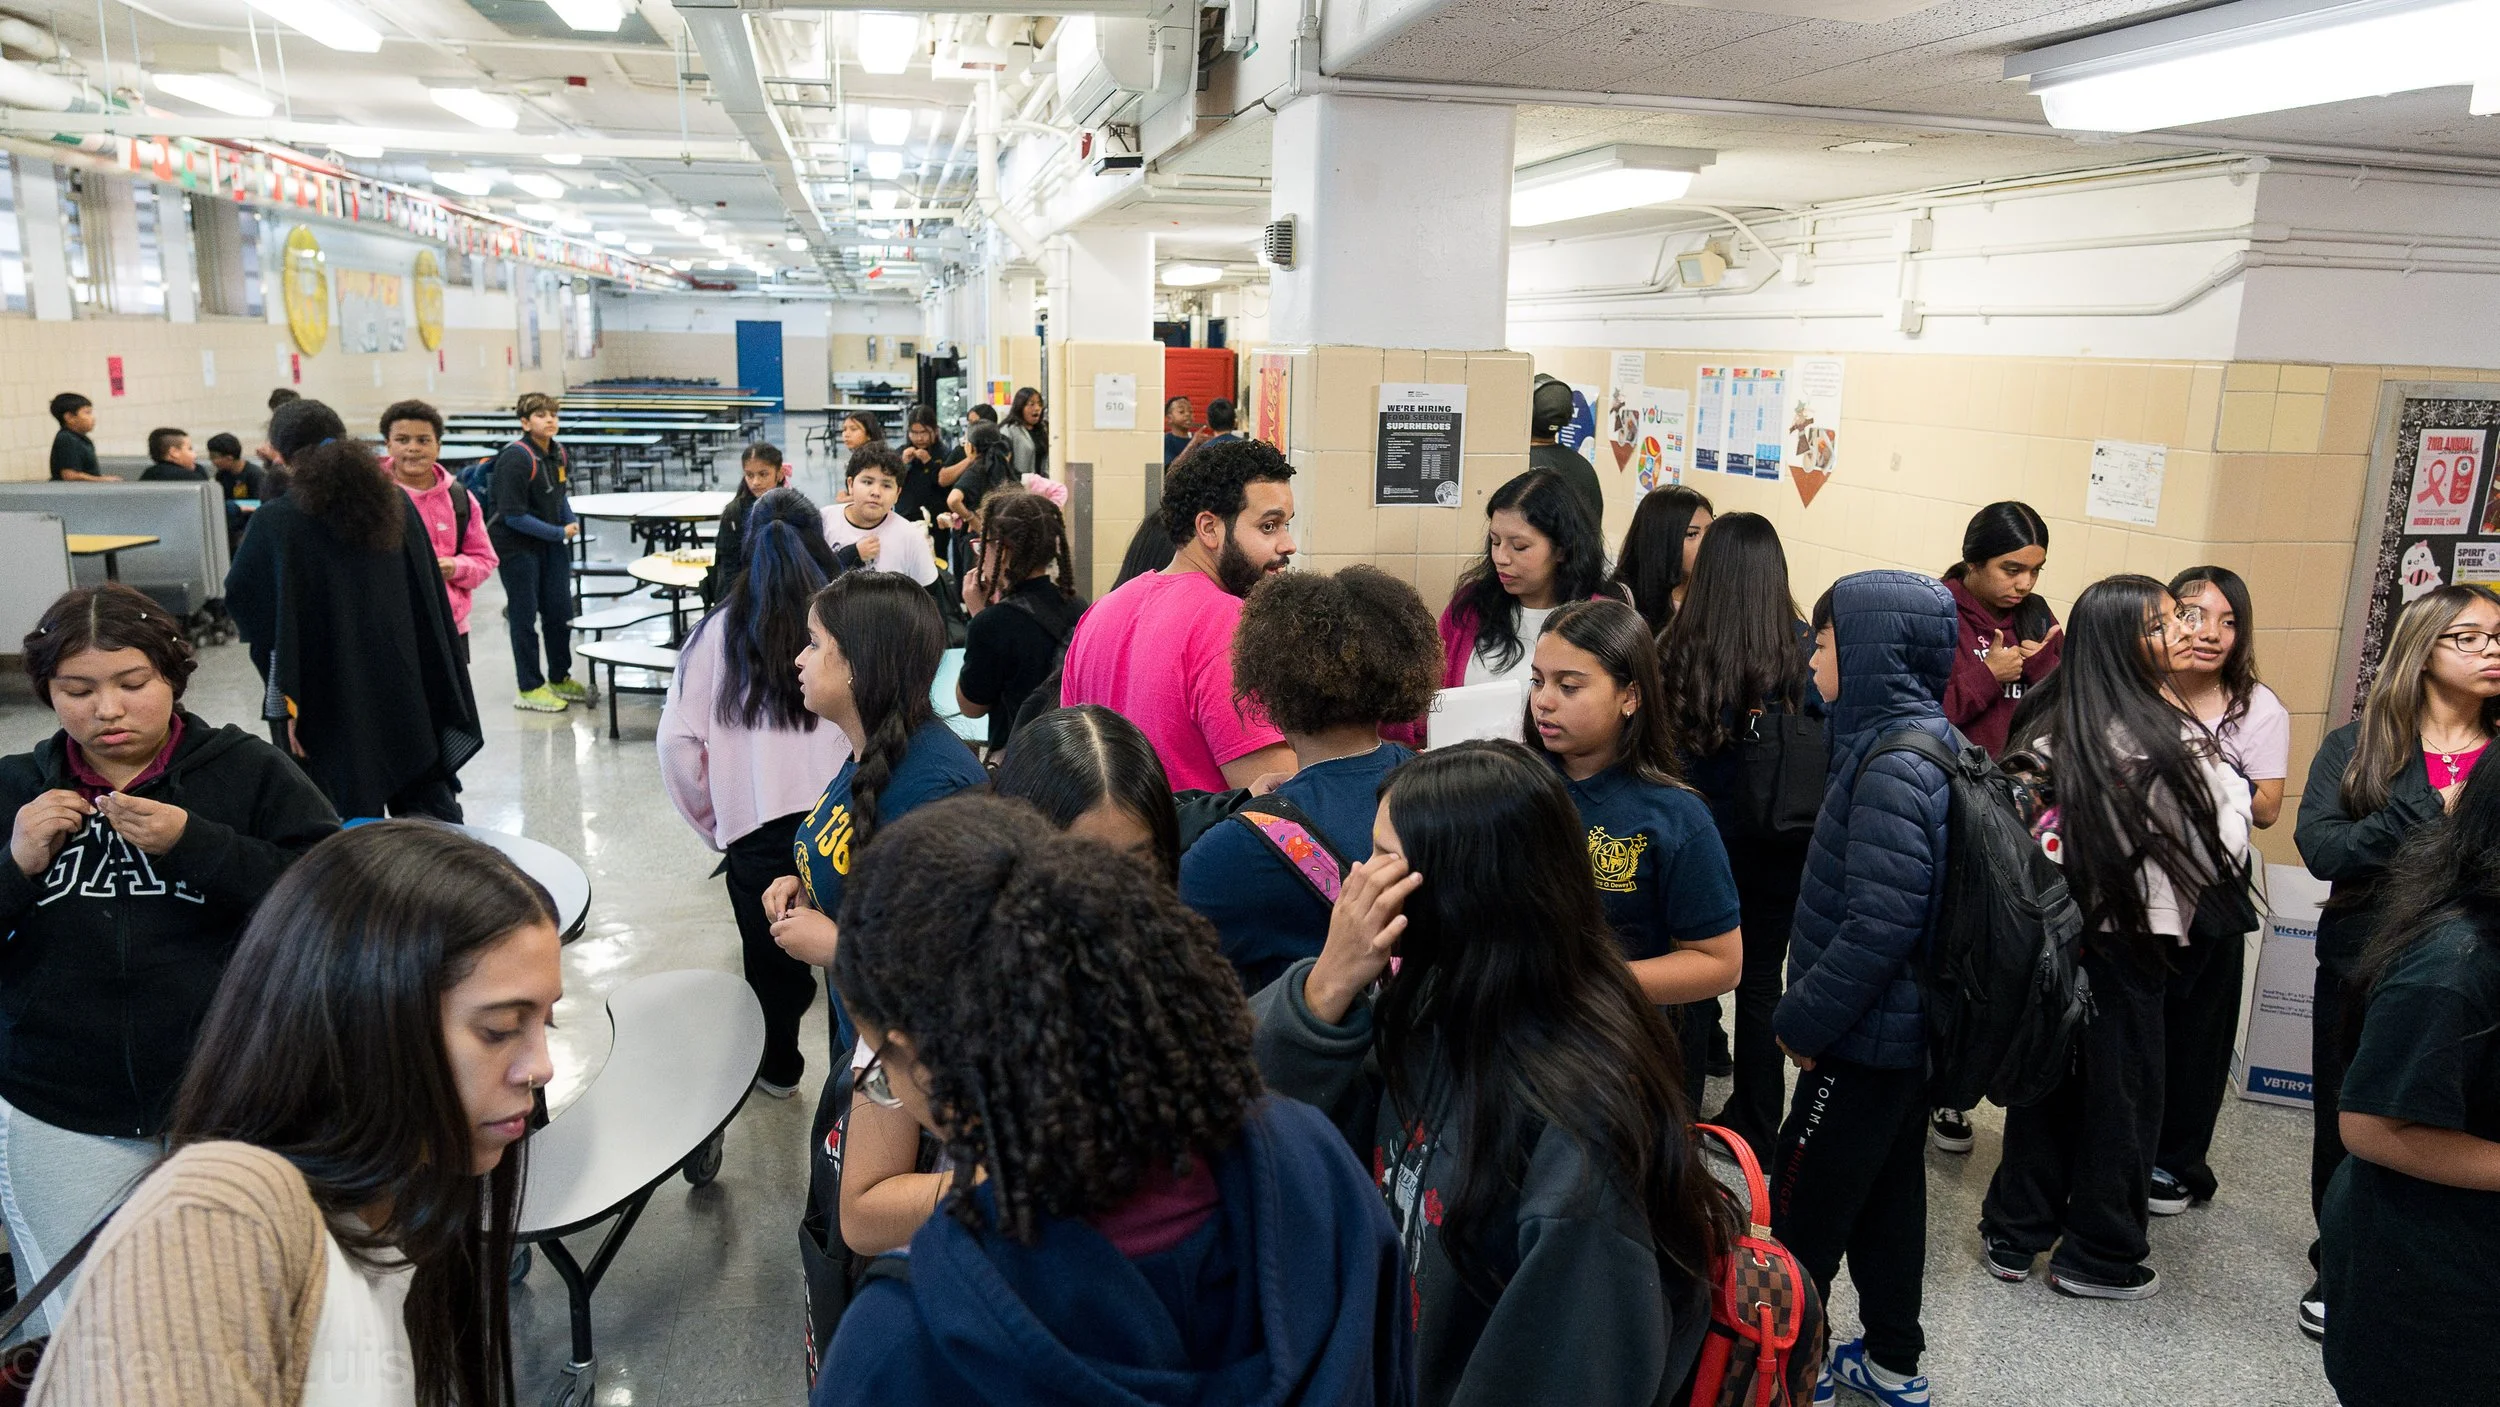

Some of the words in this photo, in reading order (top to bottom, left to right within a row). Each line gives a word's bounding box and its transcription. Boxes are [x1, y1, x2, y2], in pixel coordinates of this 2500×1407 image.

[2457, 548, 2486, 557] SPIRIT
[2458, 558, 2483, 567] WEEK
[815, 804, 854, 876] 136
[1806, 1075, 1835, 1137] TOMMY
